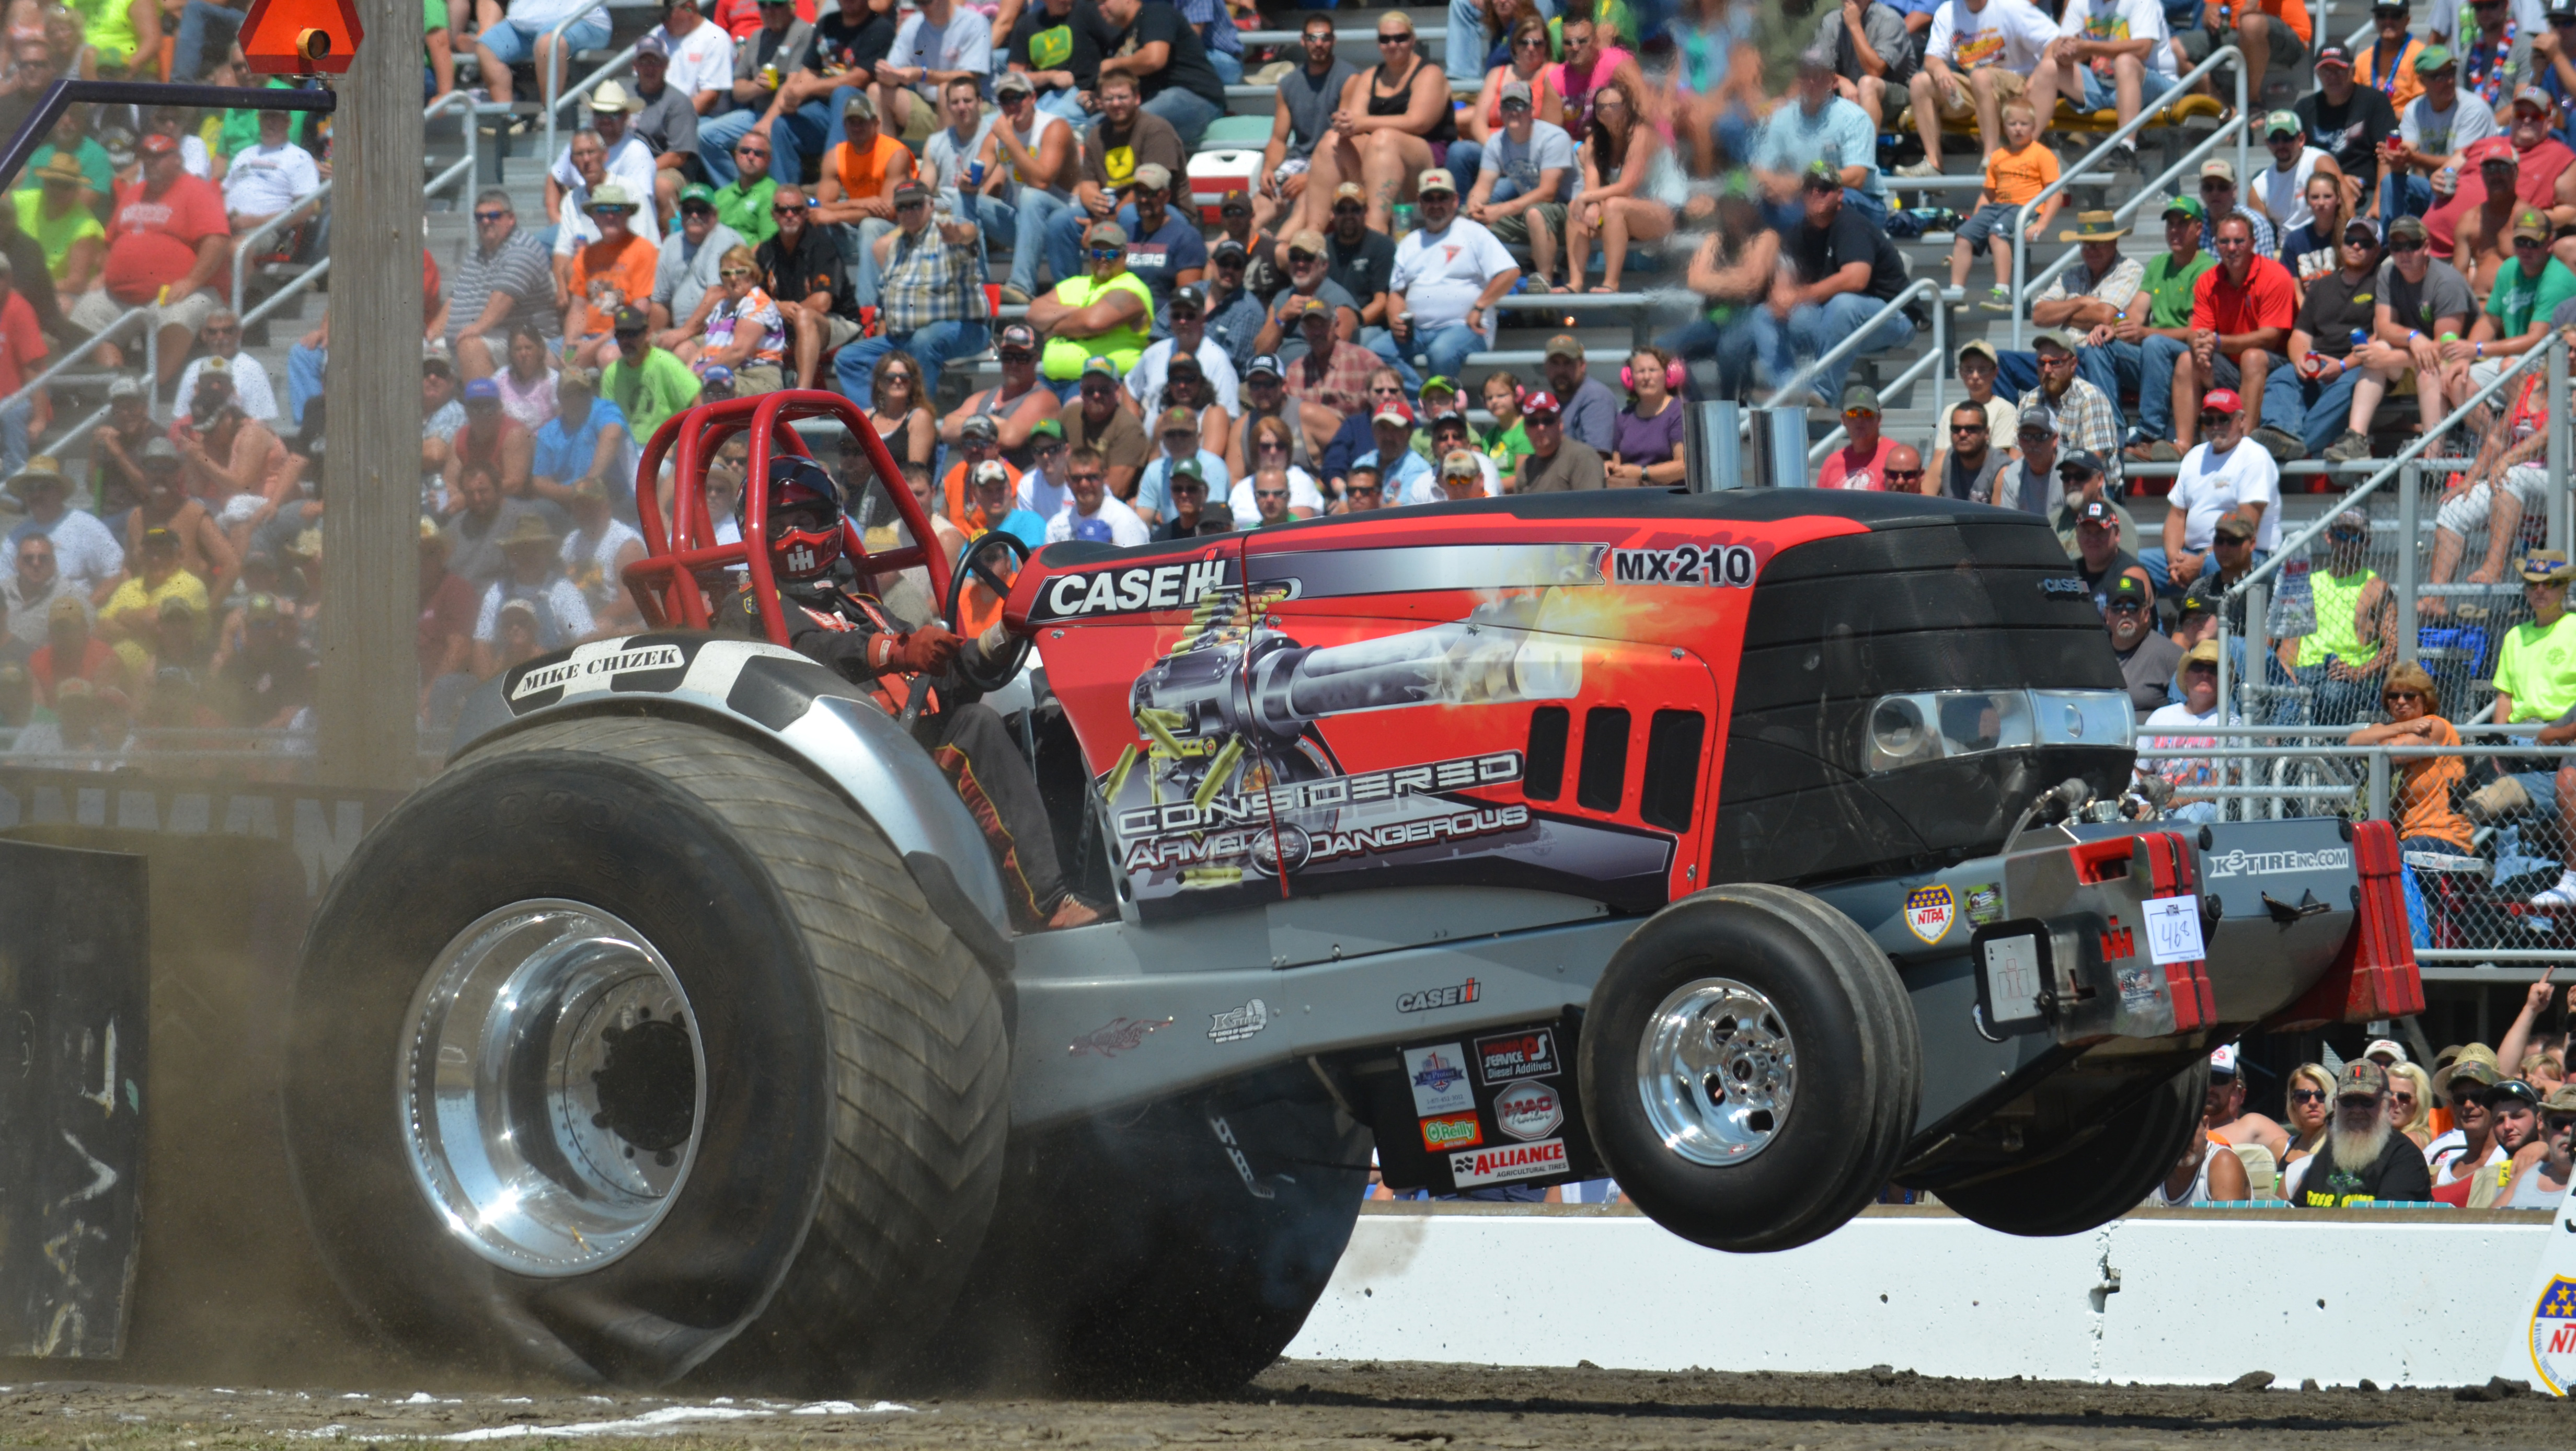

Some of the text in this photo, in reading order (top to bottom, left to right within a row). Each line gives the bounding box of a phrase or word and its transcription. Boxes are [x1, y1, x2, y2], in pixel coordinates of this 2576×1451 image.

[1615, 545, 1752, 585] MX210
[1050, 565, 1184, 616] CASE
[522, 648, 679, 693] MIKE CHIZEK
[1118, 753, 1518, 835] CONSIDERED
[1310, 805, 1529, 858] DANGEROUS
[1918, 907, 1945, 925] NTPA
[2161, 920, 2190, 950] 468
[1396, 986, 1459, 1013] CASE
[1485, 1050, 1524, 1068] SERVICE
[1488, 1061, 1552, 1079] Diesel Additives
[1431, 1070, 1455, 1080] Protect
[1503, 1096, 1553, 1118] MAC
[1510, 1107, 1551, 1125] Trailer
[1425, 1120, 1475, 1143] O'Reilly
[1474, 1143, 1564, 1176] ALLIANCE
[1496, 1162, 1567, 1179] AGRICULTURAL TIRES
[2538, 1356, 2558, 1384] TRACTOR
